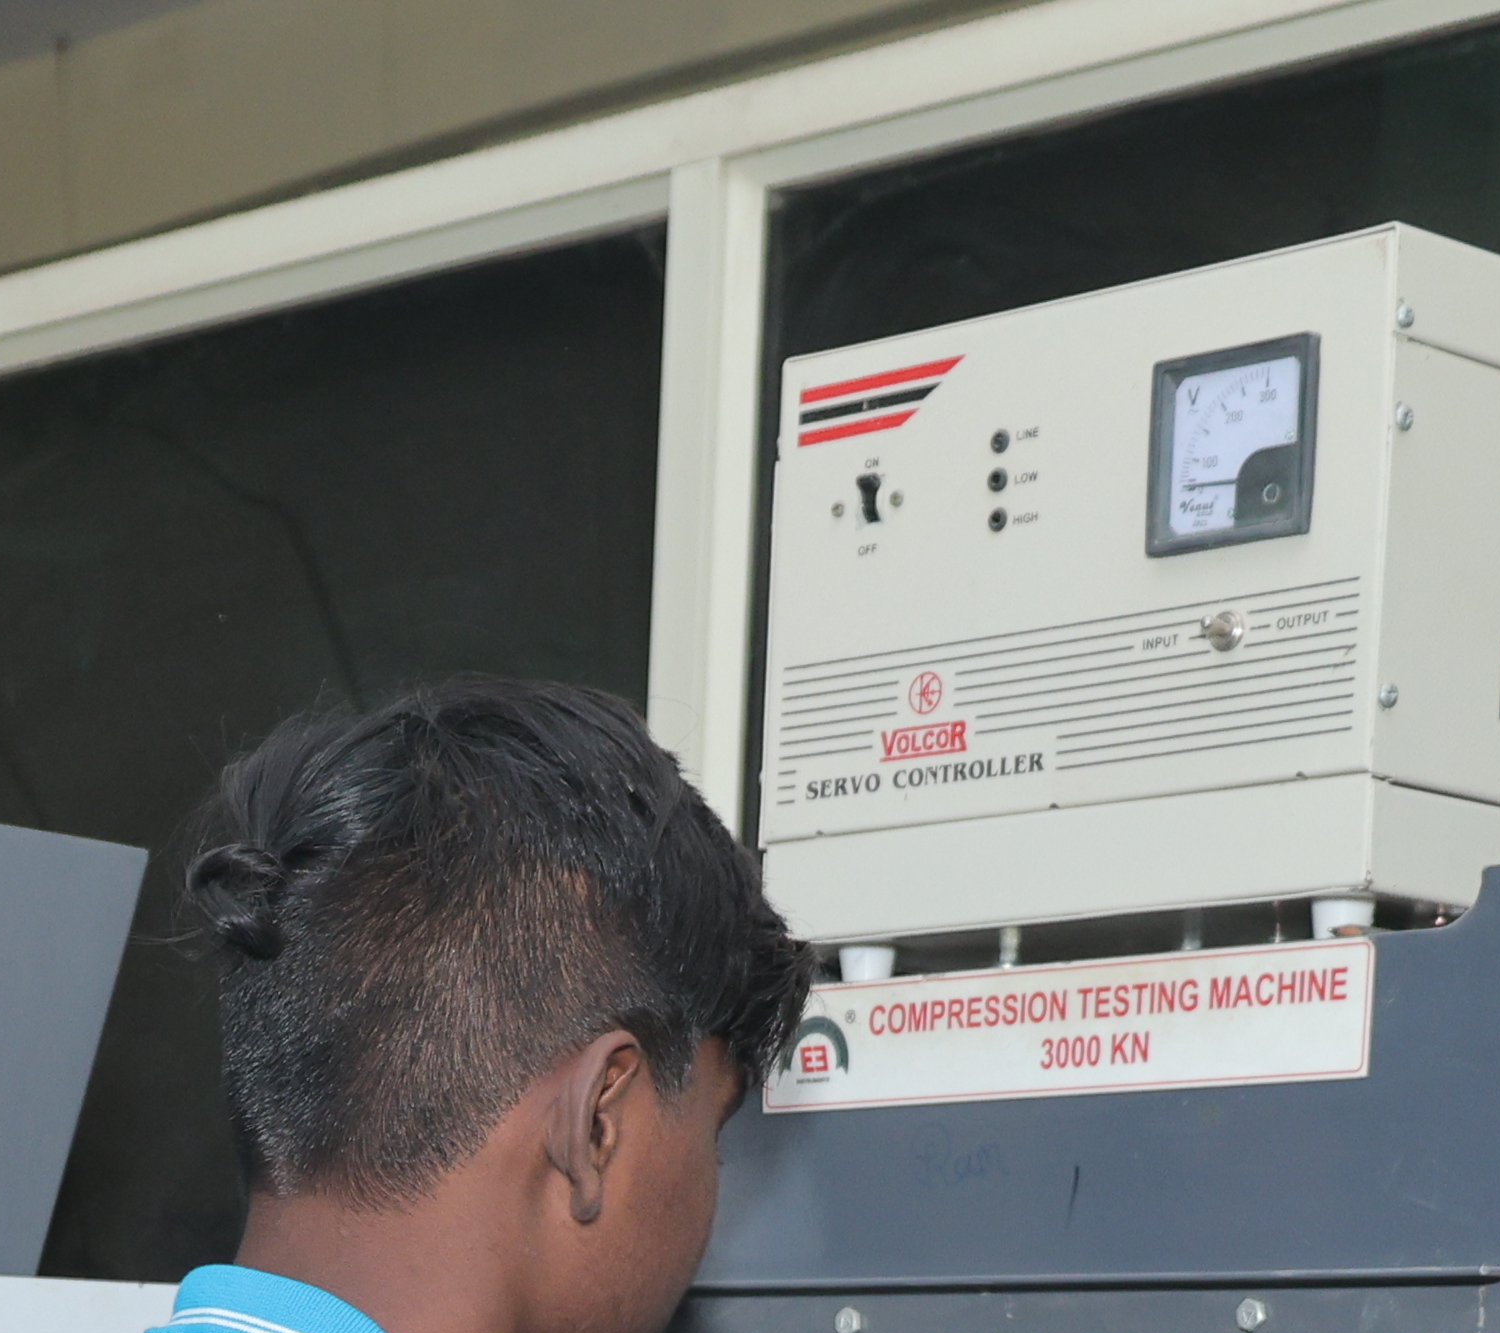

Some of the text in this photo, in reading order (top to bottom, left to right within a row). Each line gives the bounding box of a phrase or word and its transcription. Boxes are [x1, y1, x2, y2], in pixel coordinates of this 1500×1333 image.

[1188, 385, 1200, 407] V
[1259, 388, 1277, 403] 300
[1225, 410, 1244, 424] 200
[1016, 426, 1040, 441] LINE
[865, 457, 880, 469] ON
[1202, 455, 1218, 469] 100
[1014, 471, 1039, 485] LOW
[1012, 511, 1039, 526] HIGH
[858, 543, 878, 557] OFF
[1142, 610, 1329, 650] INPUT OUTPUT
[805, 752, 1045, 800] SERVO CONTROLLER
[868, 966, 1349, 1035] COMPRESSION TESTING MACHINE
[1040, 1031, 1150, 1069] 3000 KN
